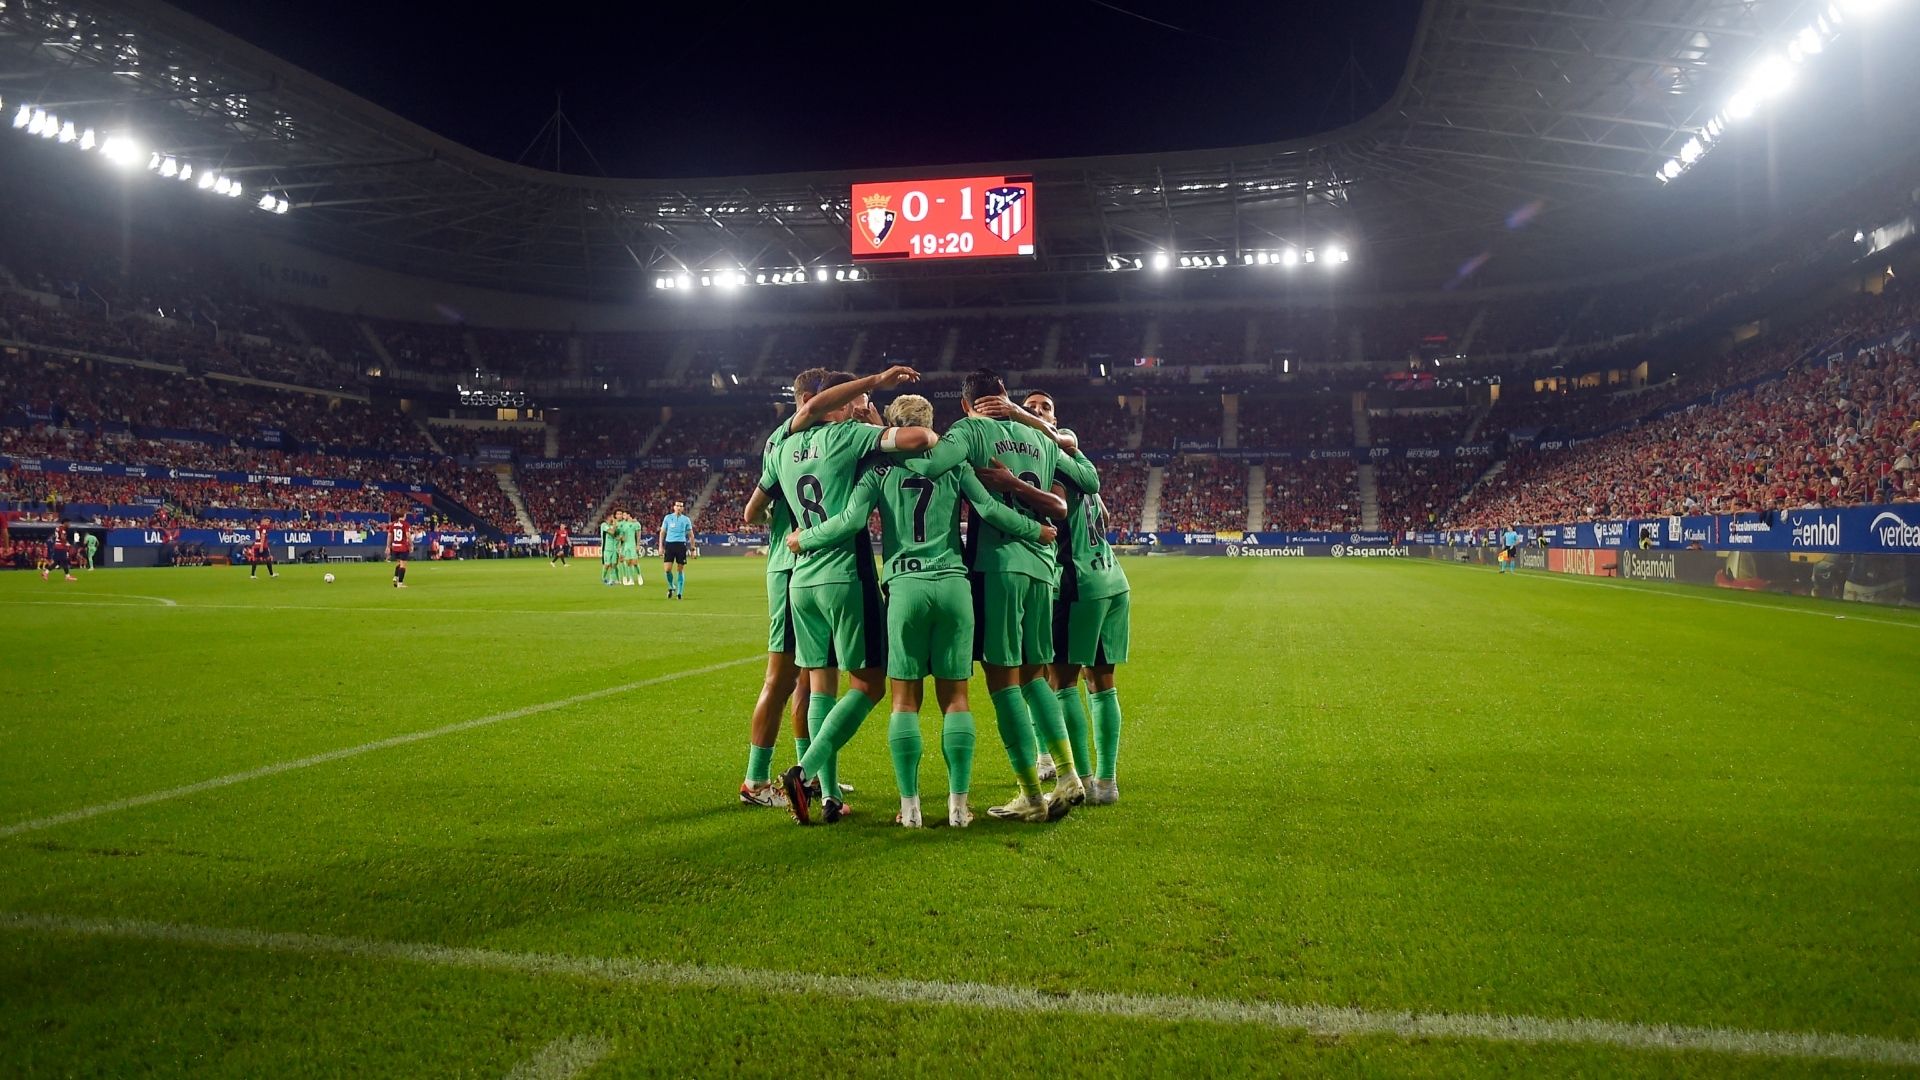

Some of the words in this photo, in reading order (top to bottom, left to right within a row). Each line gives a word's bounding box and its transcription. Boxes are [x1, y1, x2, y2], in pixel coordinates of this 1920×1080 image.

[902, 191, 929, 222] 0
[960, 186, 974, 220] 1
[909, 231, 975, 255] 19:20
[1369, 448, 1390, 457] ATP
[796, 474, 828, 530] 8
[901, 477, 935, 543] 7
[285, 532, 312, 544] LALIGA
[393, 528, 403, 542] 19
[1803, 514, 1840, 546] enhol
[578, 546, 602, 558] LALIG
[1241, 545, 1305, 558] Sagamóvil
[1346, 545, 1410, 558] Sagamóvil
[1562, 549, 1588, 574] LALIGA
[892, 553, 922, 574] ria
[1631, 553, 1675, 580] Sagamóvil
